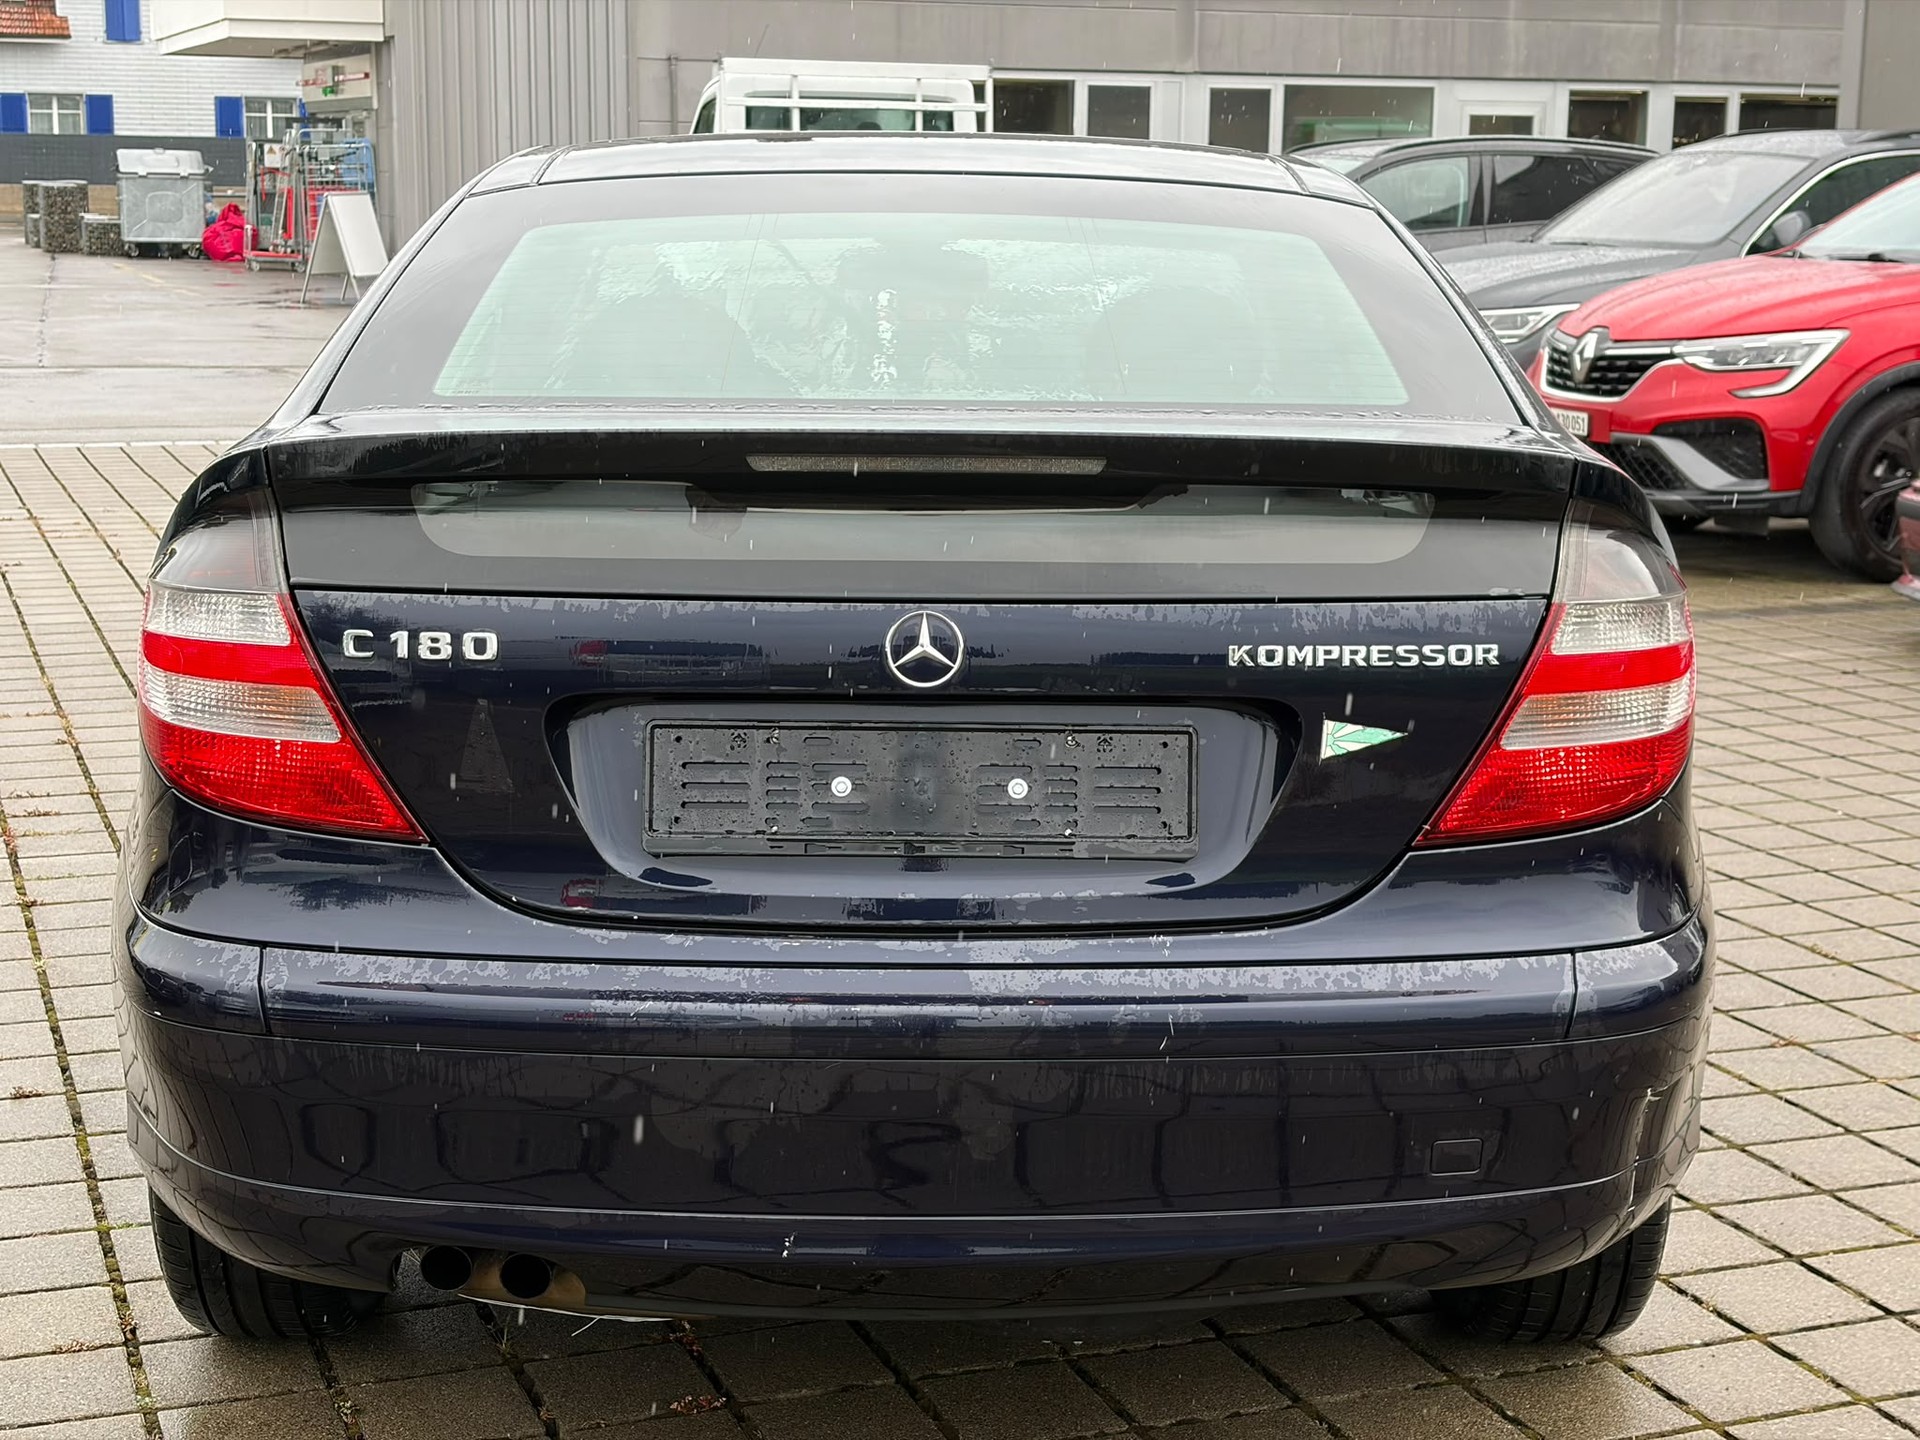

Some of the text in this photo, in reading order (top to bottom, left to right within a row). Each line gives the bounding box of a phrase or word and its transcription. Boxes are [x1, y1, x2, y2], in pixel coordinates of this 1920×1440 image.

[342, 629, 499, 661] C 180
[1228, 643, 1500, 667] KOMPRESSOR
